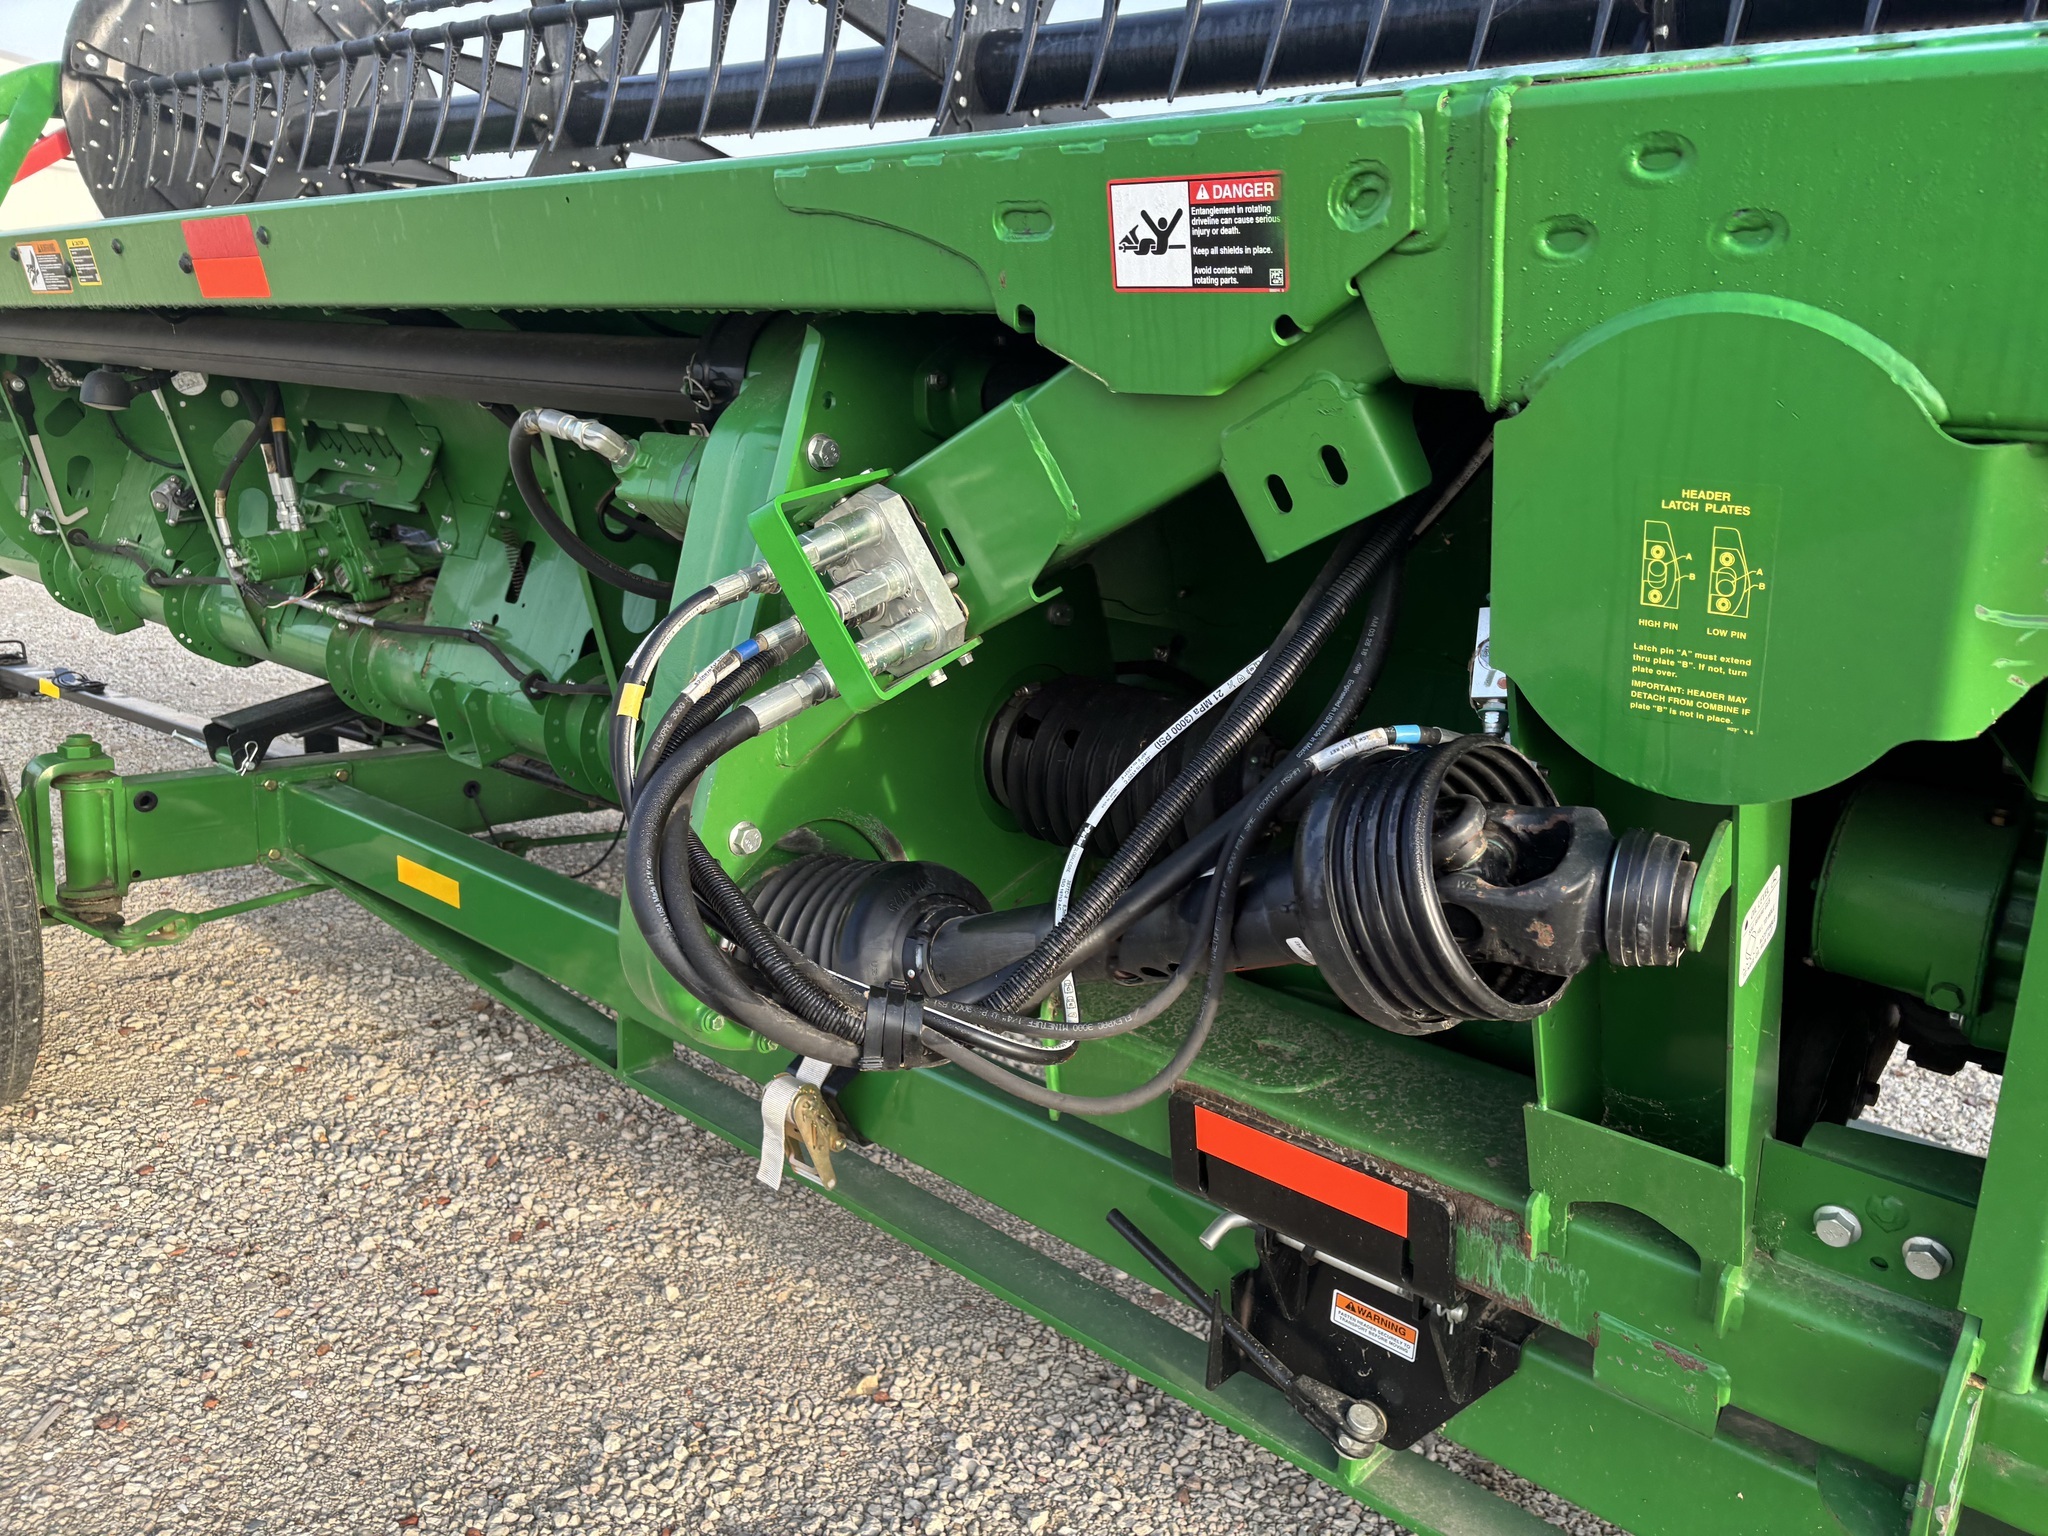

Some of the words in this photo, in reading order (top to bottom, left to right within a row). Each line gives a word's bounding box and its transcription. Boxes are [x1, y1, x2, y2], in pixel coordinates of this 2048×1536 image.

[1212, 182, 1274, 200] DANGER
[1191, 205, 1236, 217] Entanglement
[1237, 205, 1244, 214] in
[1245, 204, 1271, 214] rotating
[1191, 217, 1219, 226] driveline
[1234, 217, 1254, 225] cause
[1255, 215, 1280, 224] serious
[1191, 227, 1211, 237] injury
[1211, 228, 1219, 236] or
[1220, 226, 1241, 235] death.
[1192, 246, 1209, 257] Keep
[1210, 245, 1219, 255] all
[1219, 245, 1244, 255] shields
[1244, 245, 1251, 254] in
[1252, 245, 1273, 256] place.
[1193, 266, 1212, 275] Avoid
[1213, 266, 1238, 274] contact
[1238, 265, 1253, 274] with
[1194, 276, 1219, 286] rotating
[1220, 276, 1239, 286] parts.
[1681, 488, 1731, 502] HEADER
[1661, 499, 1699, 512] LATCH
[1704, 503, 1751, 516] PLATES
[1685, 553, 1692, 561] A
[1688, 573, 1696, 581] B
[1756, 568, 1764, 576] A
[1758, 582, 1766, 590] B
[1638, 618, 1661, 629] HIGH
[1663, 621, 1679, 631] PIN
[1706, 627, 1728, 638] LOW
[1730, 630, 1747, 640] PIN
[1633, 642, 1658, 653] Latch
[1660, 646, 1675, 656] pin
[1694, 651, 1717, 662] must
[1719, 654, 1752, 667] extend
[1631, 664, 1654, 675] plate
[1656, 669, 1678, 679] over.
[1632, 653, 1651, 663] thru
[1652, 656, 1675, 667] plate
[1698, 663, 1706, 671] If
[1707, 665, 1726, 675] not,
[1728, 668, 1748, 678] turn
[1212, 688, 1225, 702] 21
[1334, 678, 1355, 708] Engineered
[1631, 679, 1685, 695] IMPORTANT:
[1686, 688, 1726, 702] HEADER
[1727, 694, 1748, 705] MAY
[1192, 697, 1214, 716] MPa
[1630, 690, 1666, 703] DETACH
[1667, 696, 1694, 708] FROM
[1695, 701, 1740, 715] COMBINE
[1741, 707, 1752, 716] IF
[1322, 711, 1335, 725] USA
[1629, 701, 1651, 711] plate
[1669, 706, 1678, 716] is
[1679, 708, 1694, 719] not
[1695, 711, 1705, 721] in
[1706, 713, 1734, 725] place.
[651, 720, 674, 753] FLEXPAC
[669, 701, 686, 720] 3000
[1170, 713, 1194, 736] (3000
[1313, 722, 1327, 738] Made
[1154, 732, 1173, 750] PSI)
[1027, 1019, 1070, 1032] MINETUFF
[1072, 1022, 1095, 1032] 3000
[1357, 1305, 1407, 1337] WARNING
[1337, 1310, 1357, 1324] FASTEN
[1403, 1342, 1411, 1350] TO
[1338, 1315, 1368, 1333] TRANSPORT
[1368, 1330, 1388, 1344] BEFORE
[1388, 1339, 1409, 1354] MOVING
